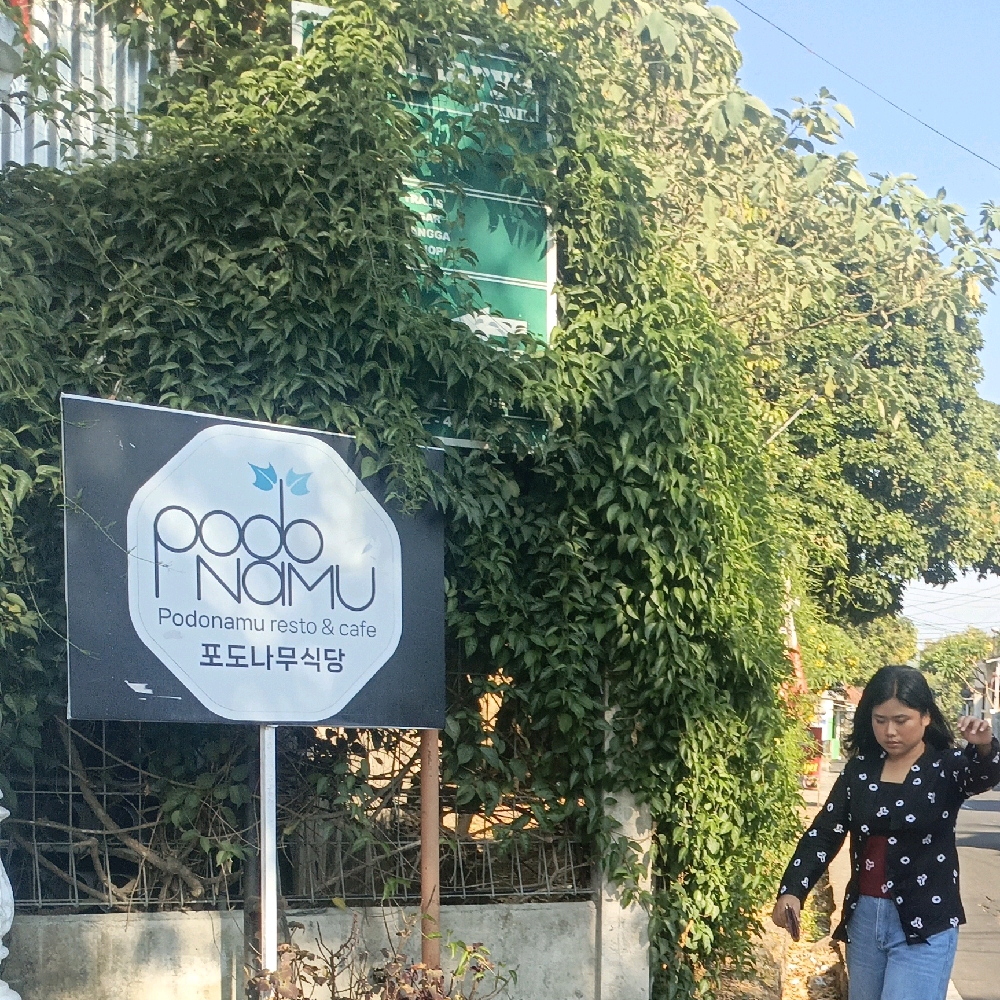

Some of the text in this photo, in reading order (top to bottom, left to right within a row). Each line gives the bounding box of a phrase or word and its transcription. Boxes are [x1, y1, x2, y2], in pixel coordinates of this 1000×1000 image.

[158, 607, 378, 639] Podonamu resto & cafe
[200, 642, 346, 674] 포도나무식당
